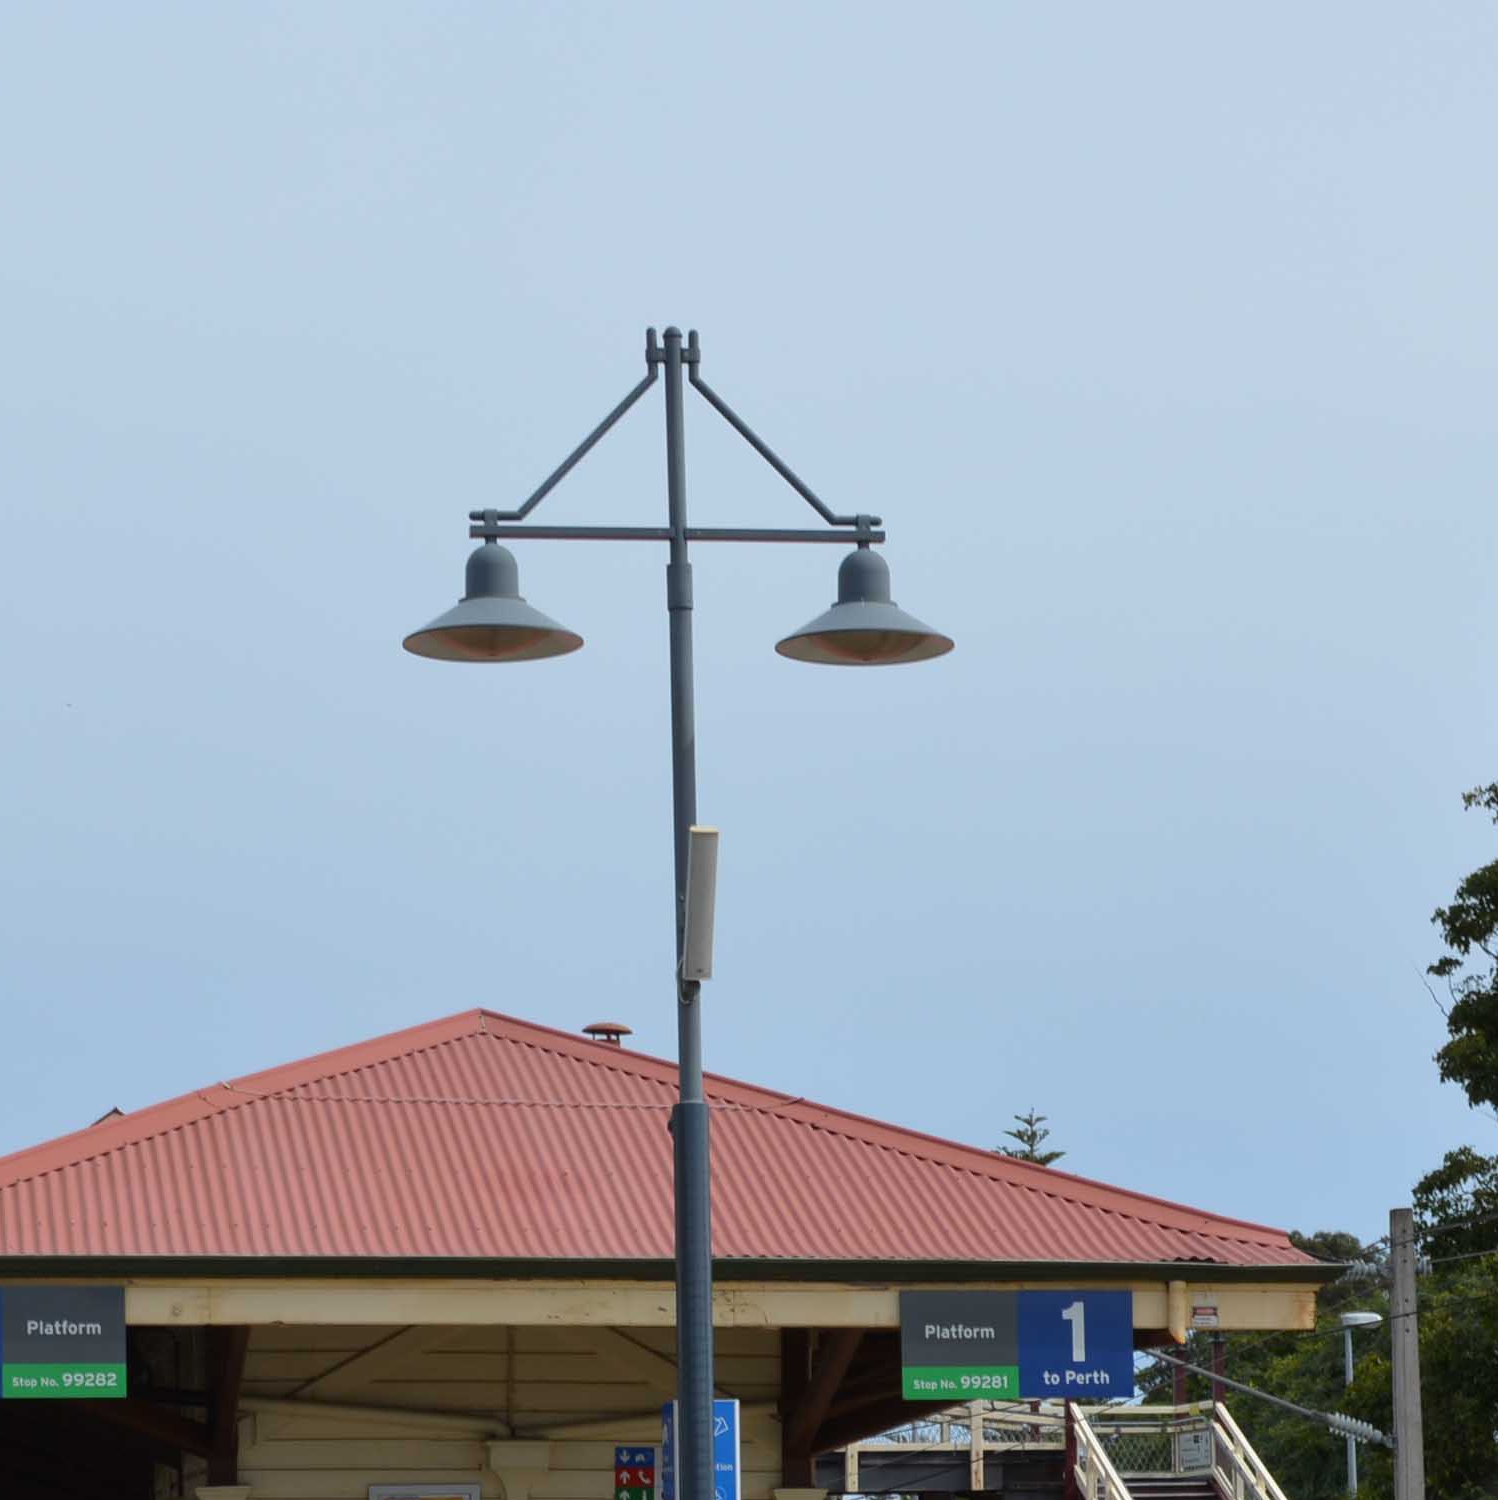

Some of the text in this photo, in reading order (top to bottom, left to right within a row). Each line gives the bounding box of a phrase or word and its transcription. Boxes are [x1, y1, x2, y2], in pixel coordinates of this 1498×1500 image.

[26, 1319, 102, 1336] Platform
[924, 1323, 996, 1340] Platform
[1061, 1301, 1087, 1362] 1
[12, 1372, 118, 1389] Stop No. 99282
[913, 1379, 940, 1391] Stop
[960, 1374, 1009, 1390] 99281
[1042, 1370, 1111, 1386] to Perth
